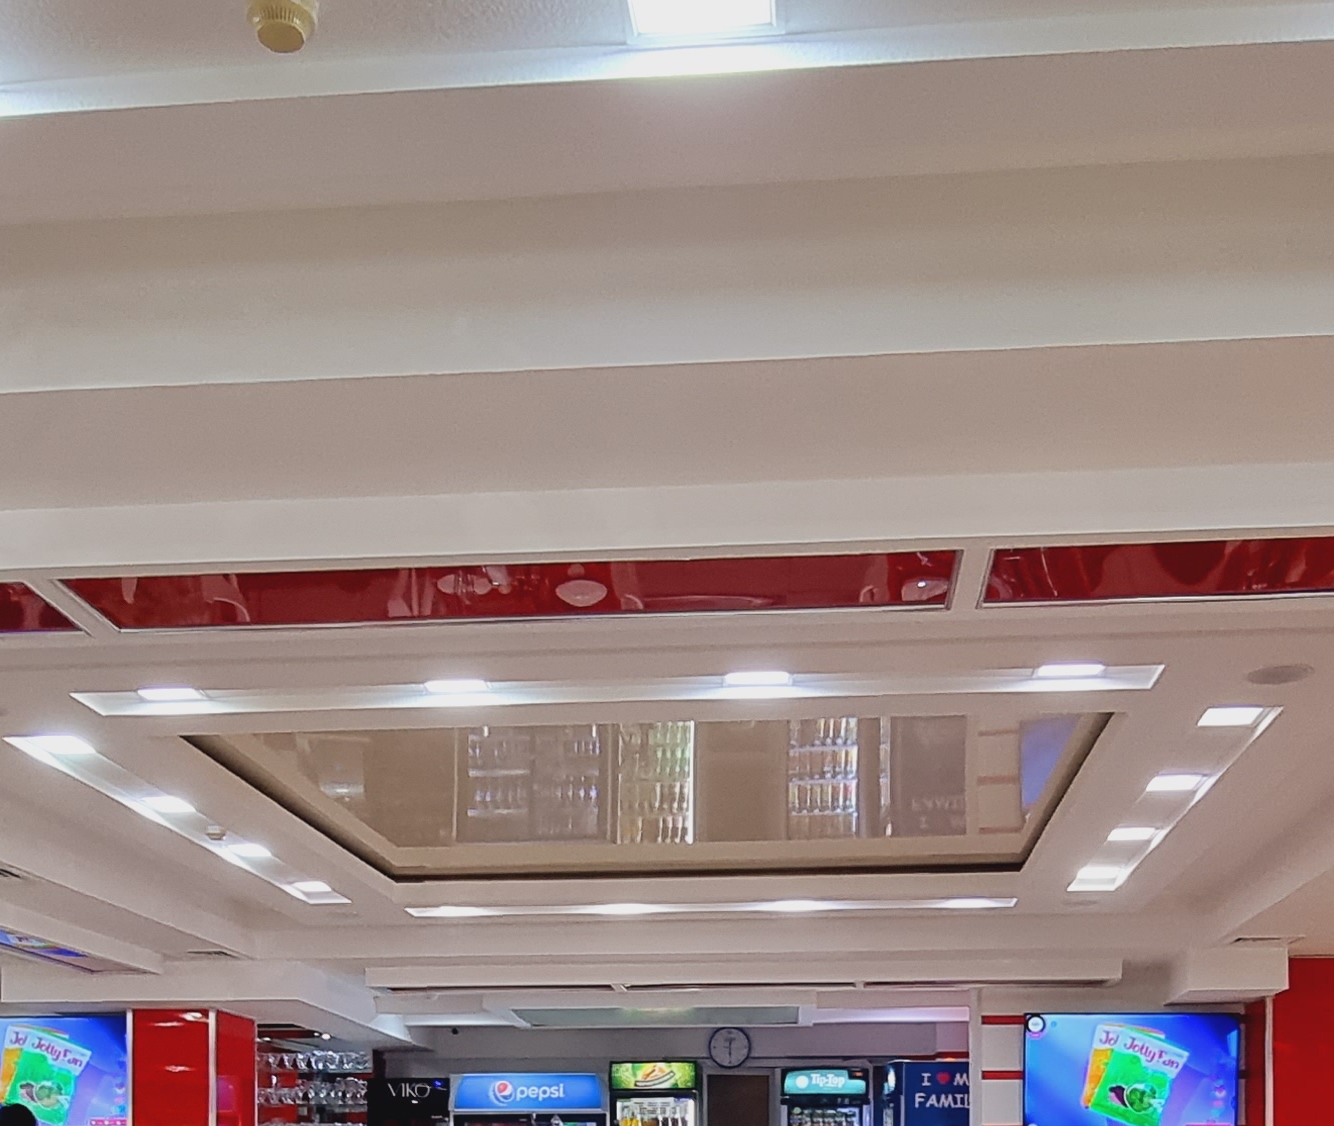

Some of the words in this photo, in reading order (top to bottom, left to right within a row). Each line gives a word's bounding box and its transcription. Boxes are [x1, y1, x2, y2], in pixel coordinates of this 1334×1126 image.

[810, 1073, 846, 1088] Tip-Top
[921, 1072, 932, 1086] I
[518, 1083, 565, 1101] pepsi
